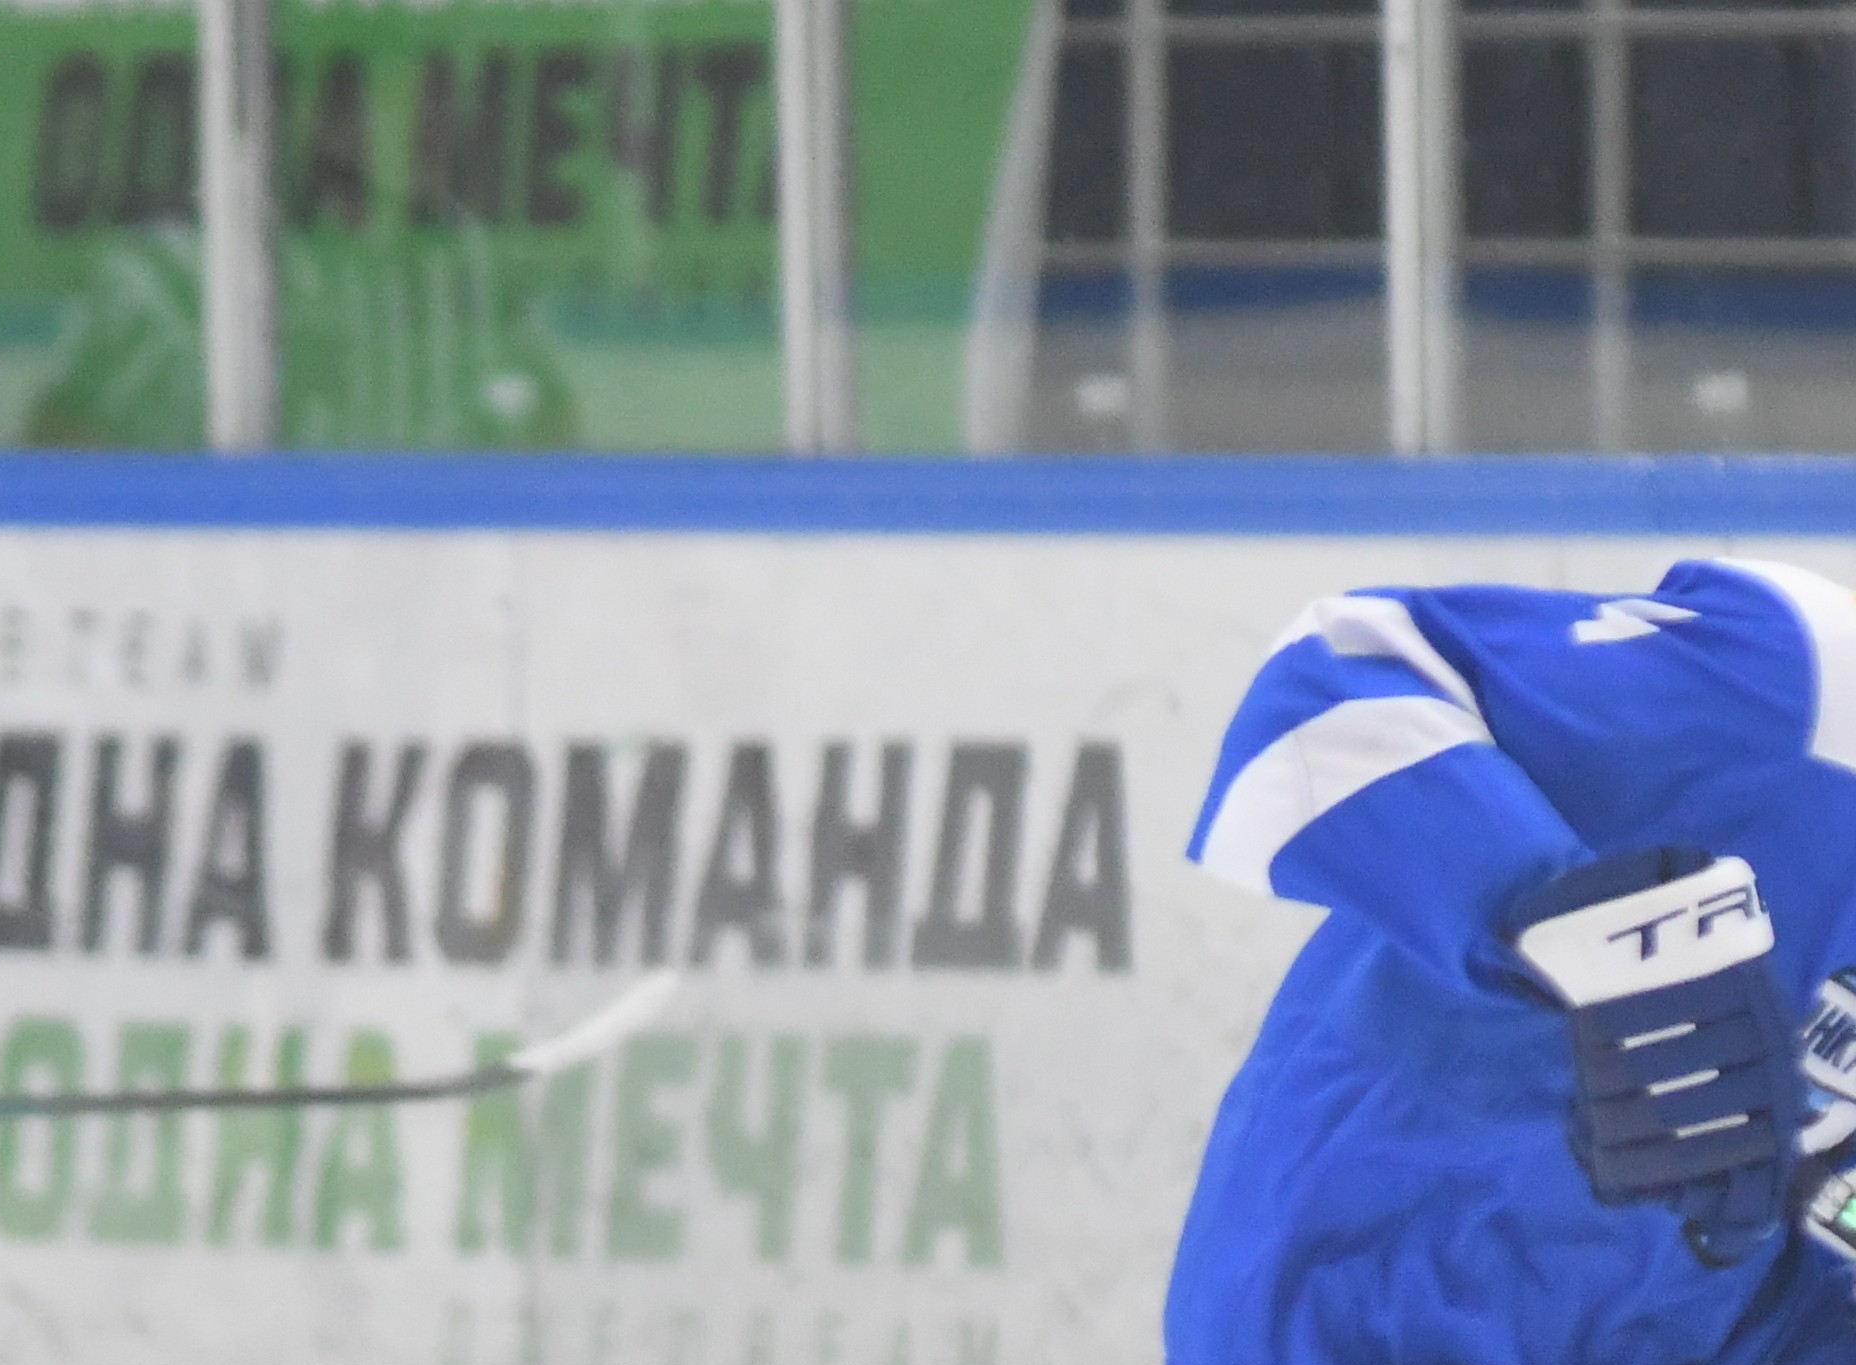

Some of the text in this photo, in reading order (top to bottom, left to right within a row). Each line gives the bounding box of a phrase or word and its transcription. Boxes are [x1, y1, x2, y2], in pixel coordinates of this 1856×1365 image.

[32, 38, 784, 232] ОДА МЕЧТ
[320, 738, 1136, 974] КОМАНДА
[449, 1028, 1008, 1270] МЕЧТА
